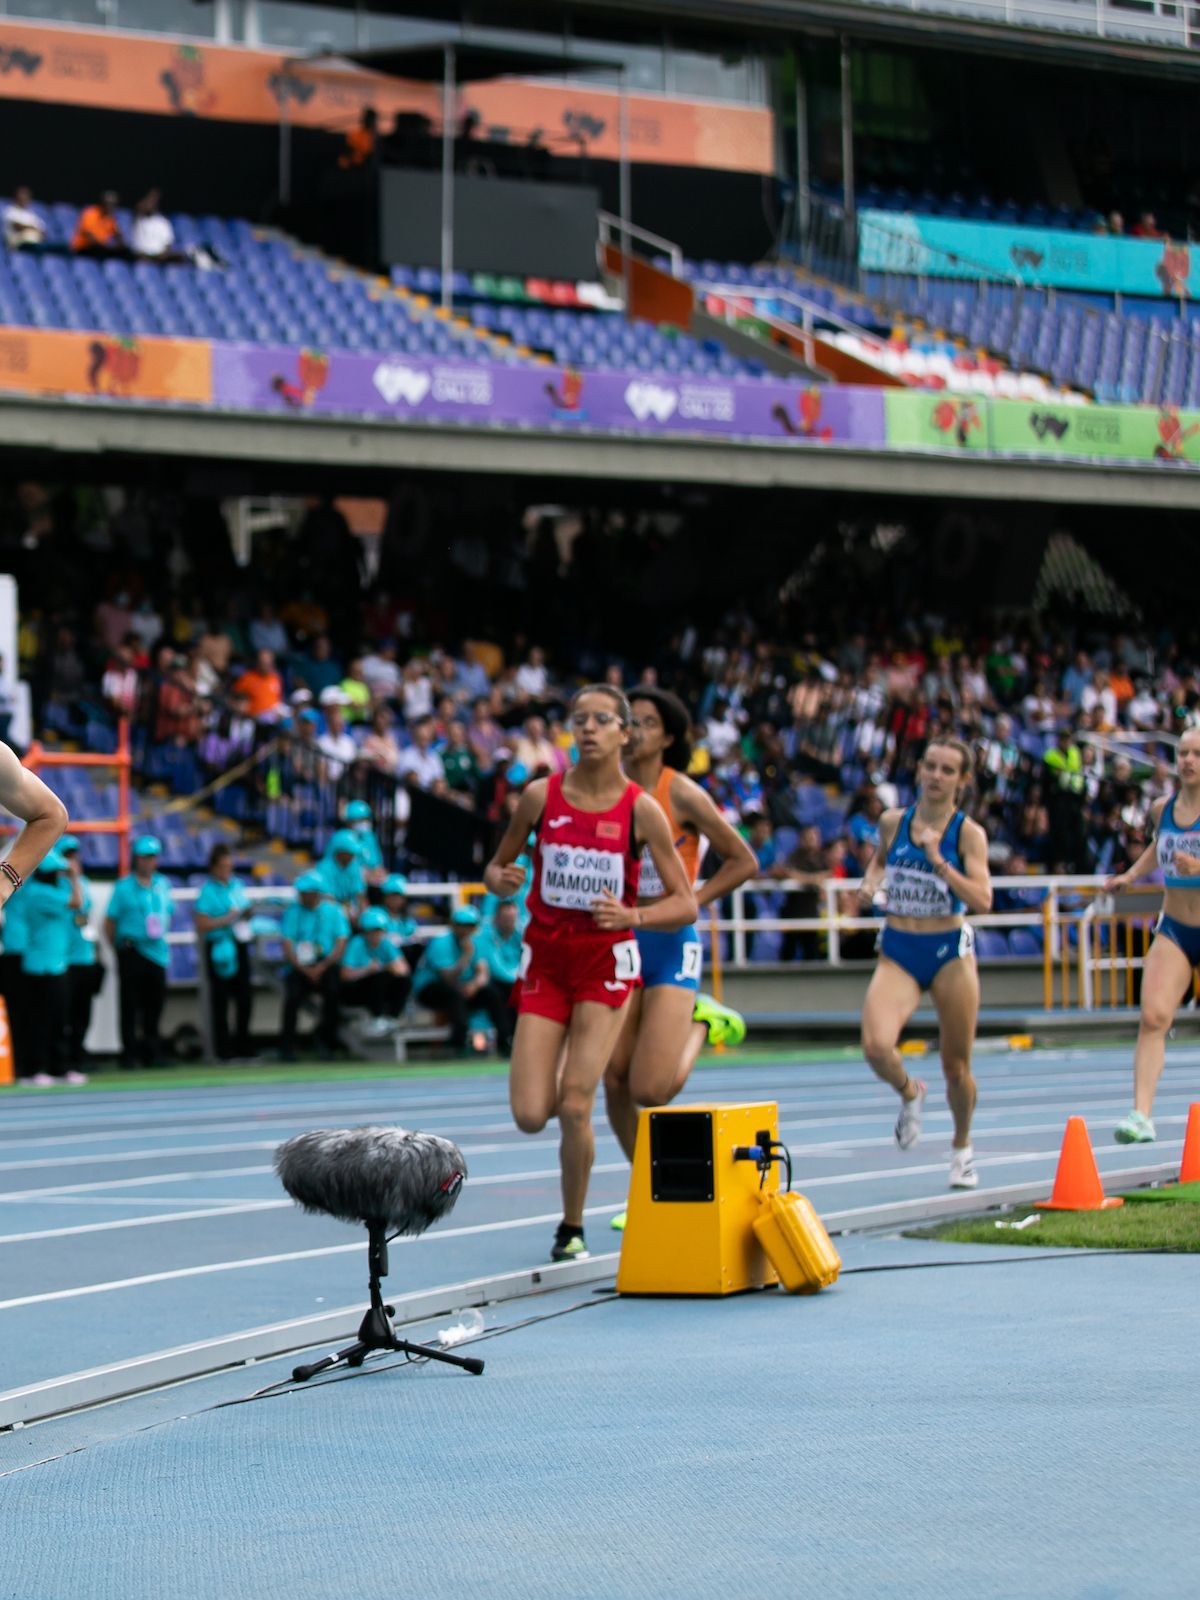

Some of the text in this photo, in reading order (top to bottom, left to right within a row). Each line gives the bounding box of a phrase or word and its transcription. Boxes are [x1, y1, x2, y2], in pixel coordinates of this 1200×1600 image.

[573, 854, 611, 872] QNB
[545, 871, 618, 895] MAMOUNI
[626, 948, 634, 973] 1
[689, 948, 698, 971] 7
